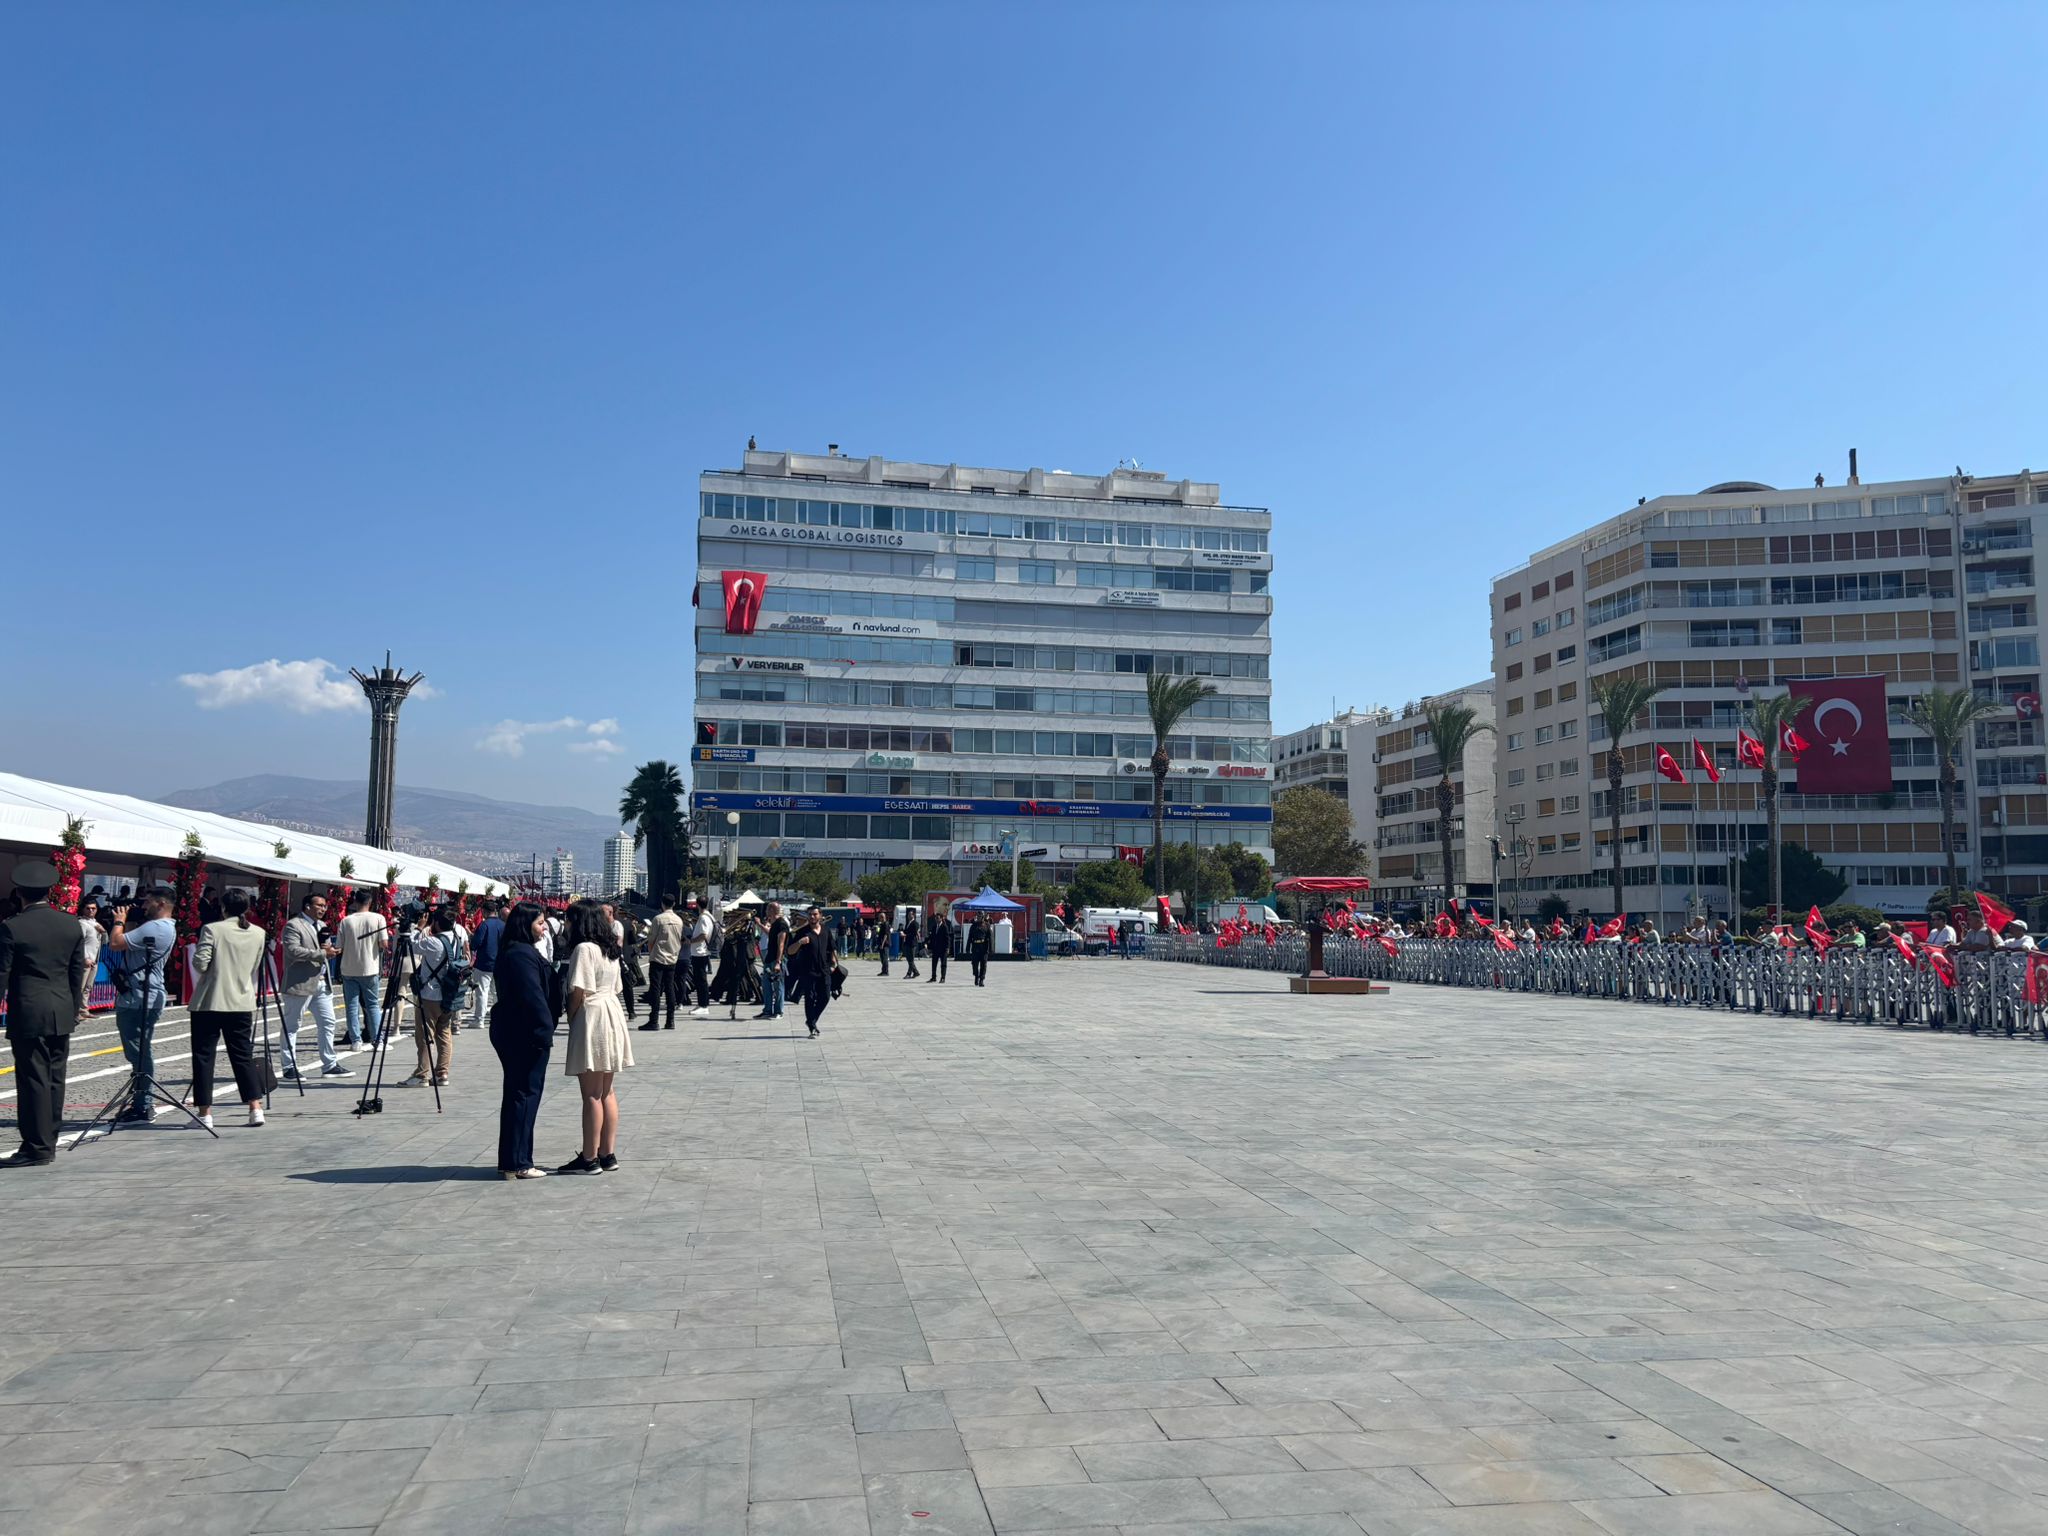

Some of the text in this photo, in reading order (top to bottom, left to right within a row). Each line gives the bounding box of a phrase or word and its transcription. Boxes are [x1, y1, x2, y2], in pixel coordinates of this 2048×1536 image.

[730, 525, 903, 546] OMEGA GLOBAL LOGISTICS
[781, 840, 806, 848] Crowe
[963, 843, 1004, 855] LÖSEV
